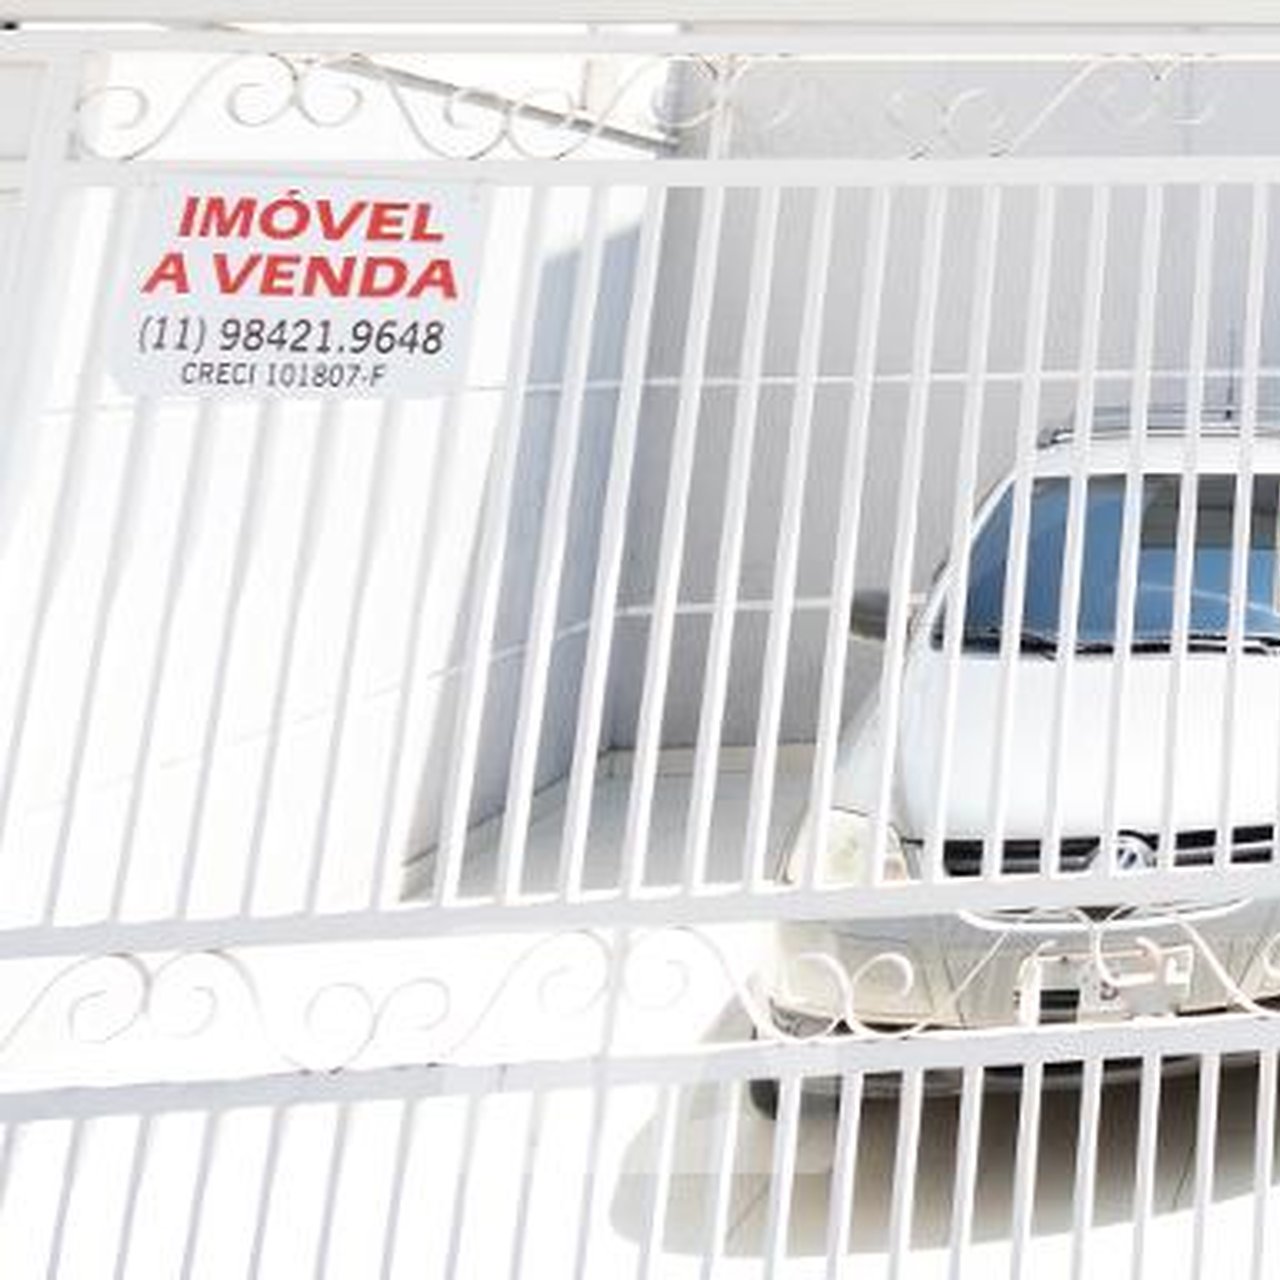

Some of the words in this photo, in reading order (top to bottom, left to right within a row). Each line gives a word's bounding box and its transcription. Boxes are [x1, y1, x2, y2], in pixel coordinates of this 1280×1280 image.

[178, 189, 445, 242] IMÓVEL
[140, 252, 190, 294] A
[212, 253, 458, 299] VENDA
[138, 316, 207, 354] (11)
[218, 318, 445, 355] 98421.9648
[181, 362, 255, 386] CRECI
[268, 363, 388, 388] 101807-F
